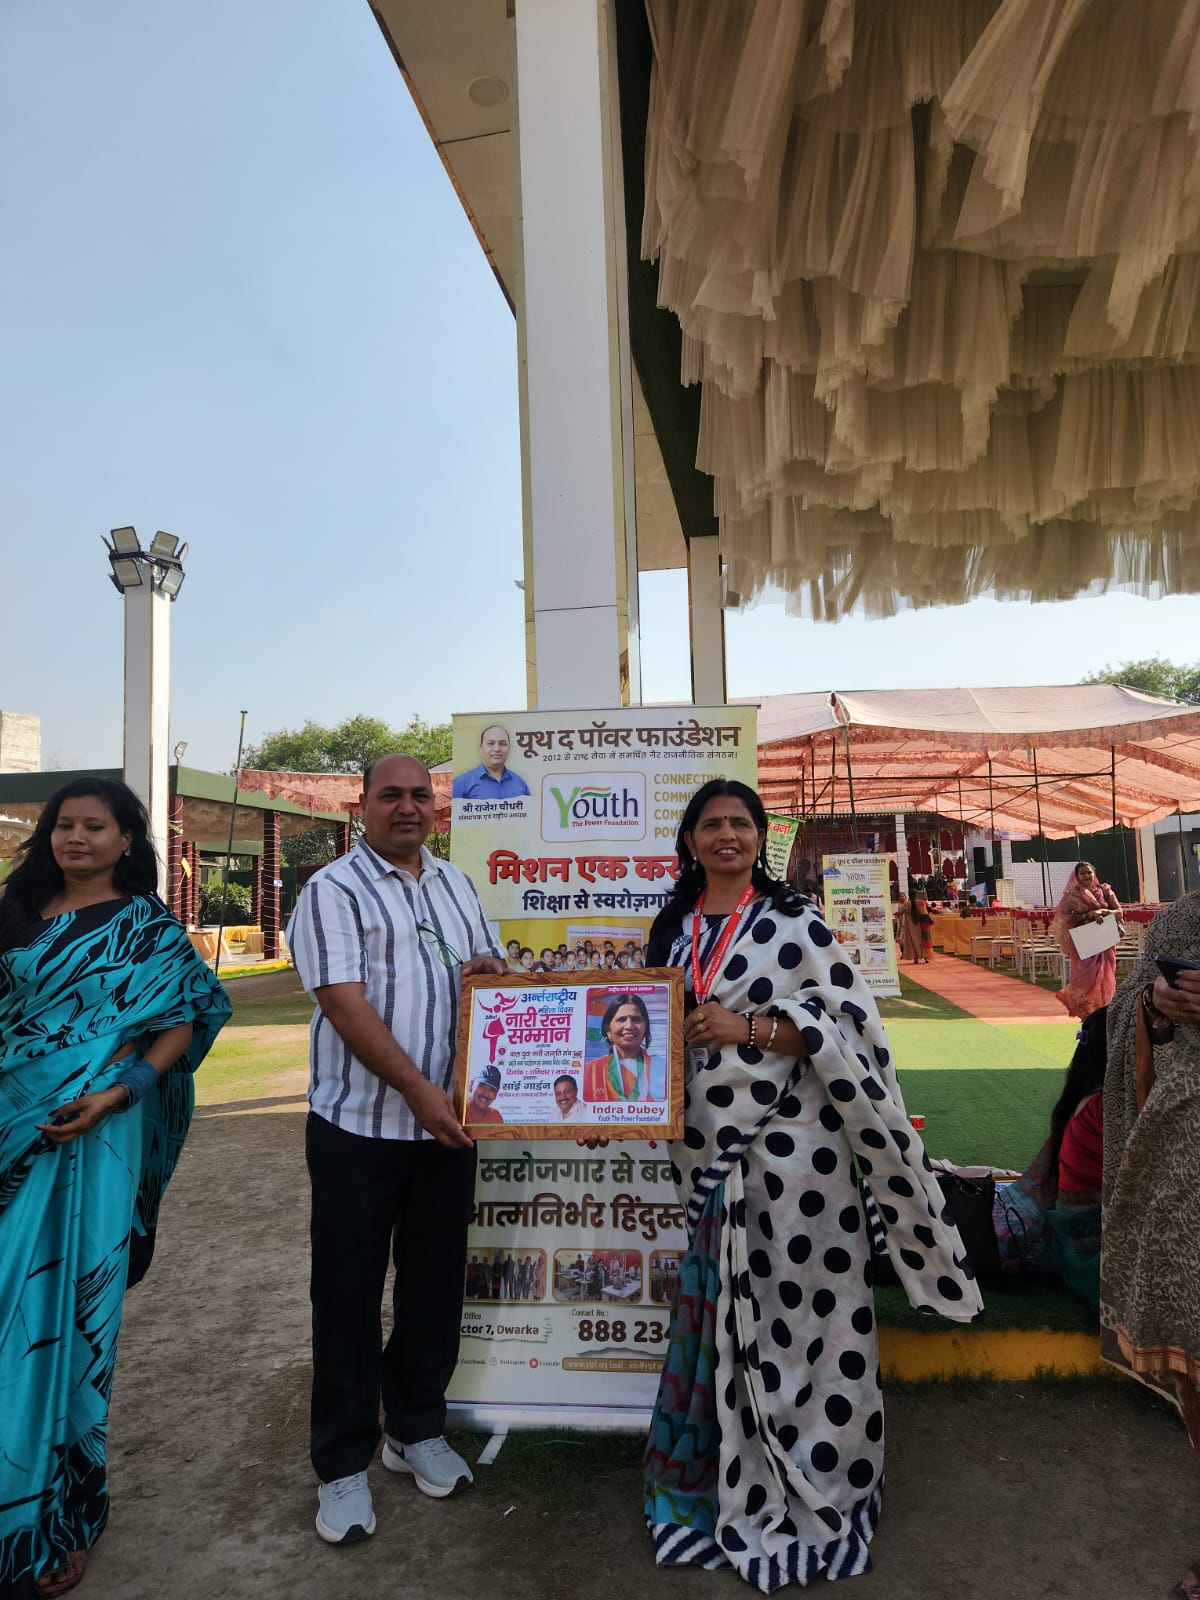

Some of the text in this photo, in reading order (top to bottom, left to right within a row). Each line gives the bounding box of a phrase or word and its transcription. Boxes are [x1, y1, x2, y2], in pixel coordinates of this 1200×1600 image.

[516, 719, 741, 758] यूथ द पॉवर फाउंडेशन
[543, 754, 561, 762] 2012
[564, 752, 572, 761] से
[462, 802, 473, 812] श्री
[475, 801, 497, 812] राजेश
[549, 787, 639, 828] Youth
[604, 819, 639, 827] Foundation
[654, 827, 677, 838] POV
[487, 849, 572, 884] मिशन
[575, 855, 630, 883] एक
[522, 889, 571, 913] शिक्षा
[573, 889, 590, 911] से
[505, 1006, 573, 1028] नारी रत्न
[507, 1027, 571, 1044] सम्मान
[592, 1105, 665, 1116] Indra Dubey
[479, 1151, 606, 1184] स्वरोजगार
[610, 1152, 635, 1183] से
[464, 1311, 481, 1320] Office
[572, 1309, 594, 1317] Contact
[460, 1325, 484, 1335] ctor
[496, 1325, 539, 1335] Dwarka
[578, 1319, 627, 1342] 888
